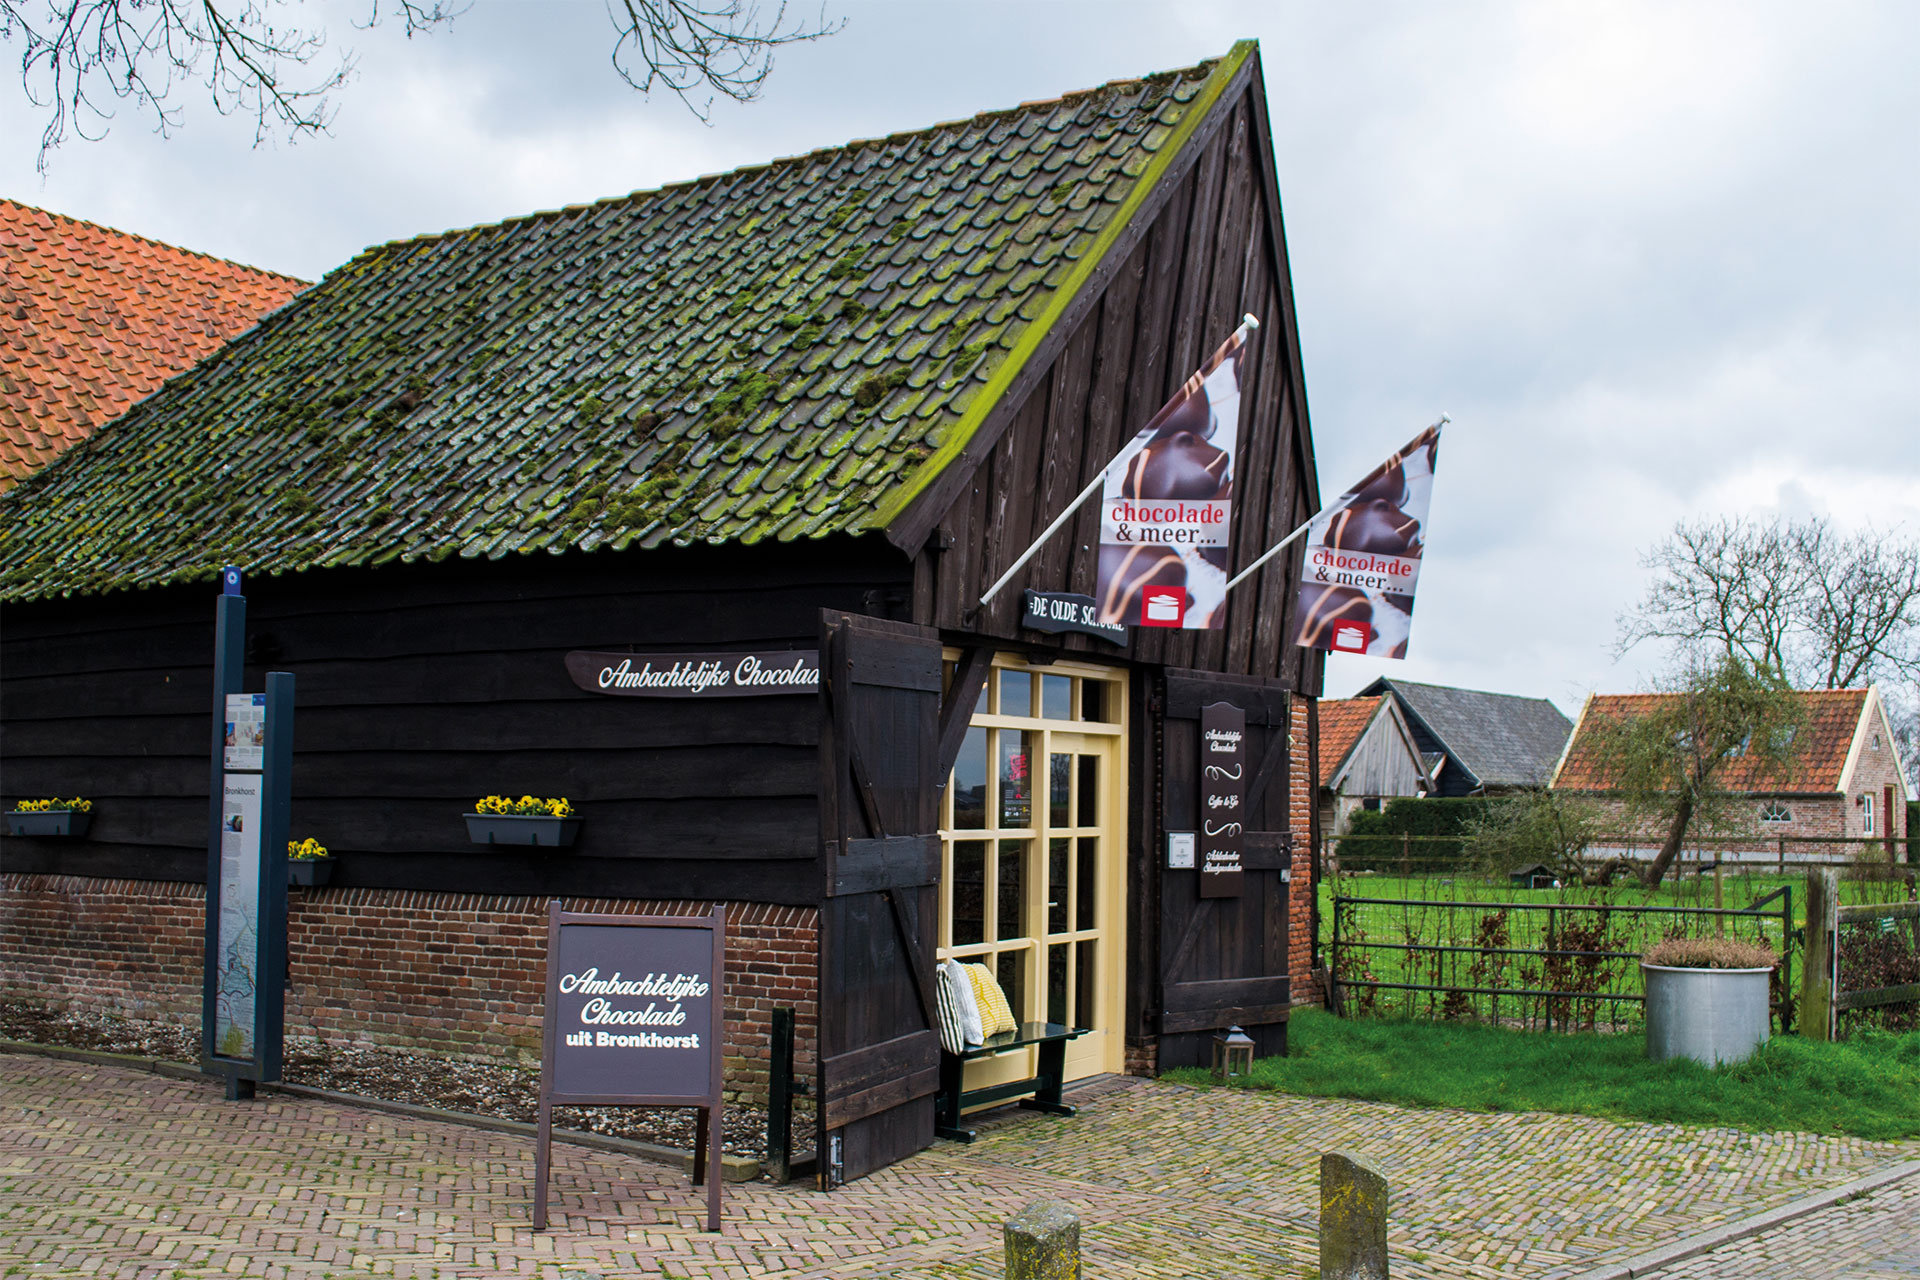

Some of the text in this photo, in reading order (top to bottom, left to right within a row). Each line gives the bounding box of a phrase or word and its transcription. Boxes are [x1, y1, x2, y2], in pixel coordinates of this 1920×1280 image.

[1111, 502, 1224, 524] chocolade
[1116, 523, 1217, 544] & meer...
[1313, 550, 1412, 577] chocolade
[1315, 566, 1404, 593] & meer...
[1050, 599, 1078, 622] OLDE
[598, 658, 730, 694] Ambachtelijke
[225, 787, 256, 796] Bronkhorst
[559, 967, 709, 1003] Ambachtelijke
[581, 997, 687, 1026] Chocolade
[566, 1031, 700, 1049] uit Bronkhorst
